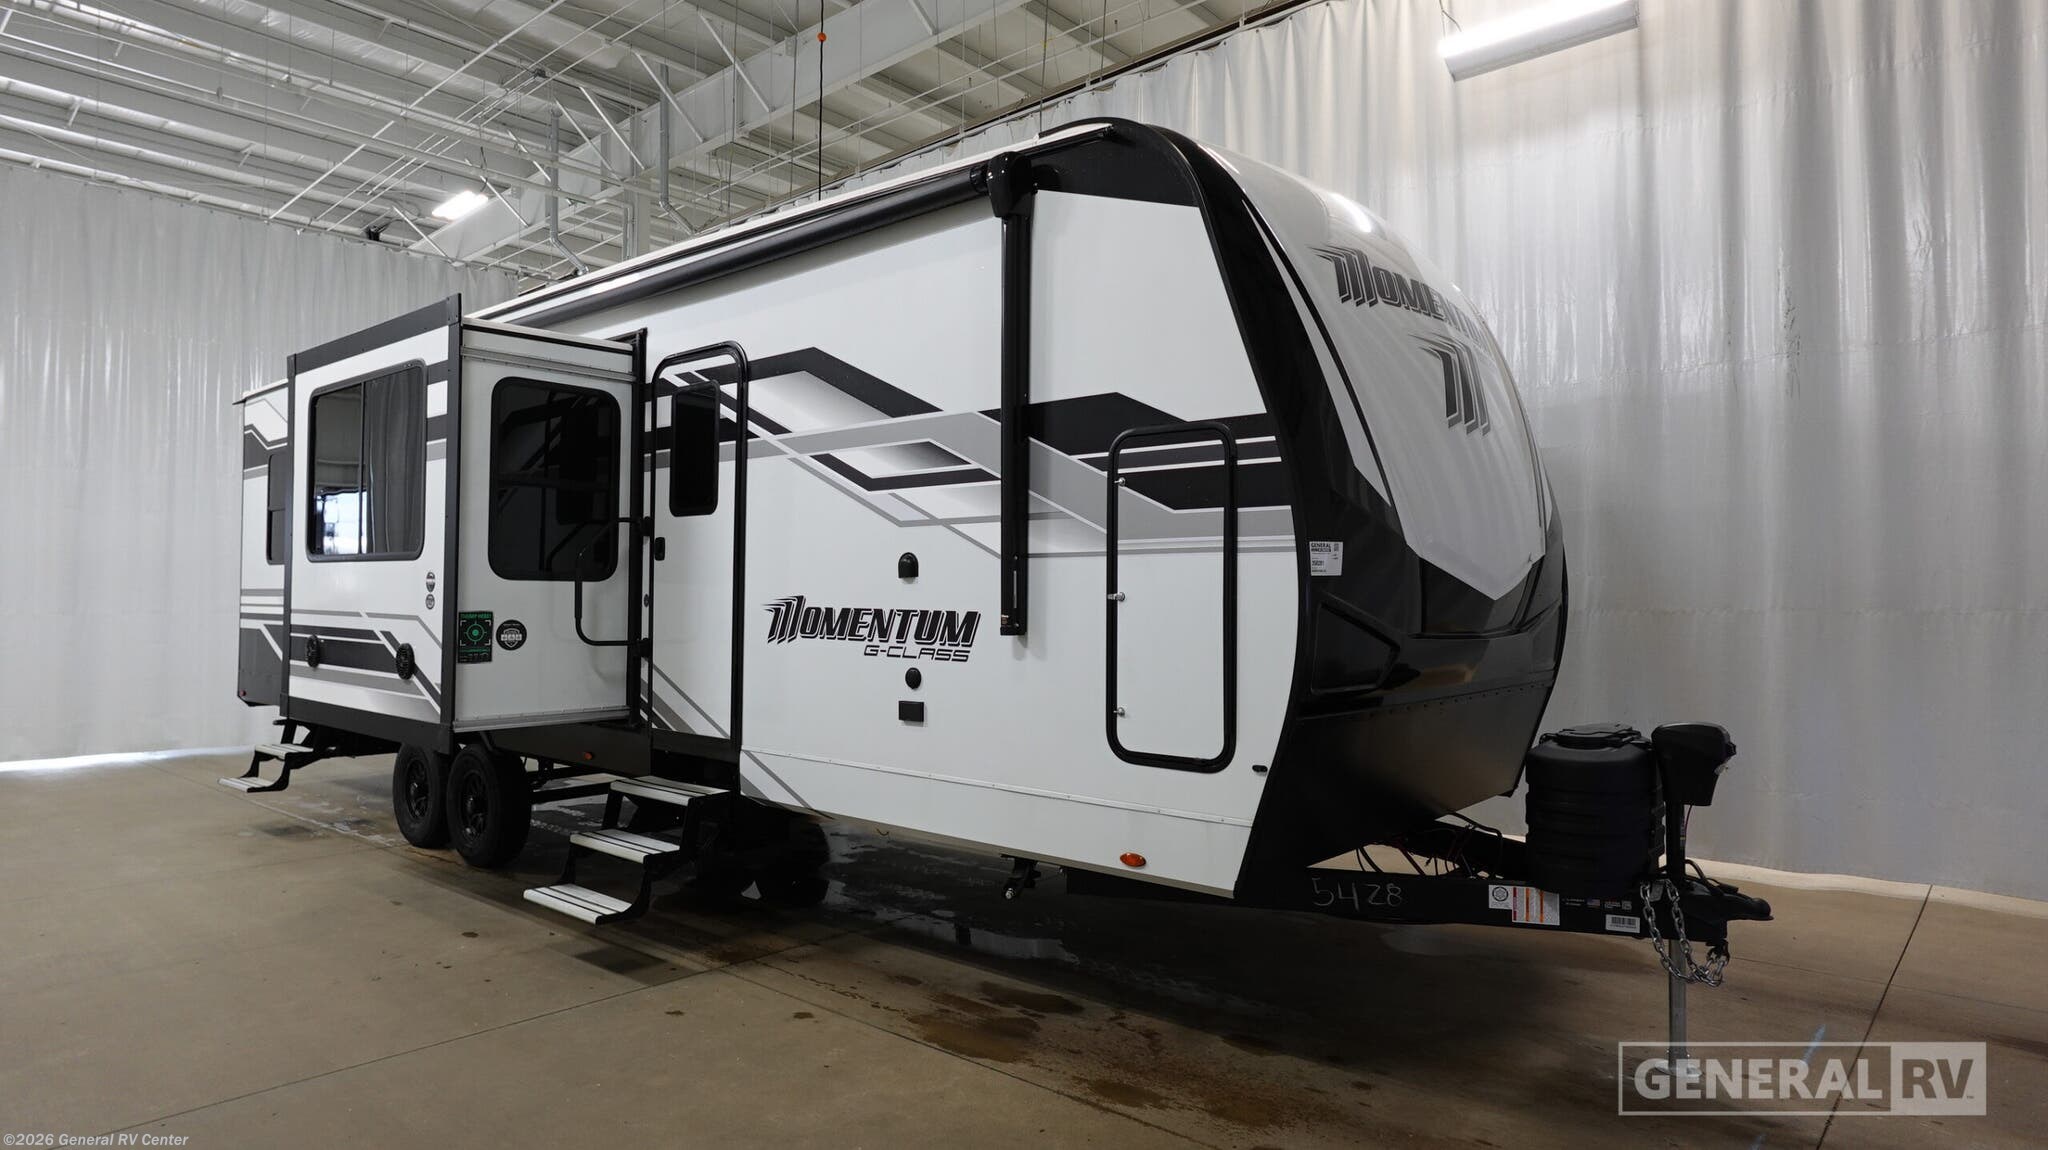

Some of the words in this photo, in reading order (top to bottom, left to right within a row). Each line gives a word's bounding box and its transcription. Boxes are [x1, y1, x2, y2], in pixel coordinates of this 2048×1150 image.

[761, 595, 982, 647] MOMENTUM
[864, 644, 971, 662] G-CLASS
[1311, 877, 1405, 911] 5428
